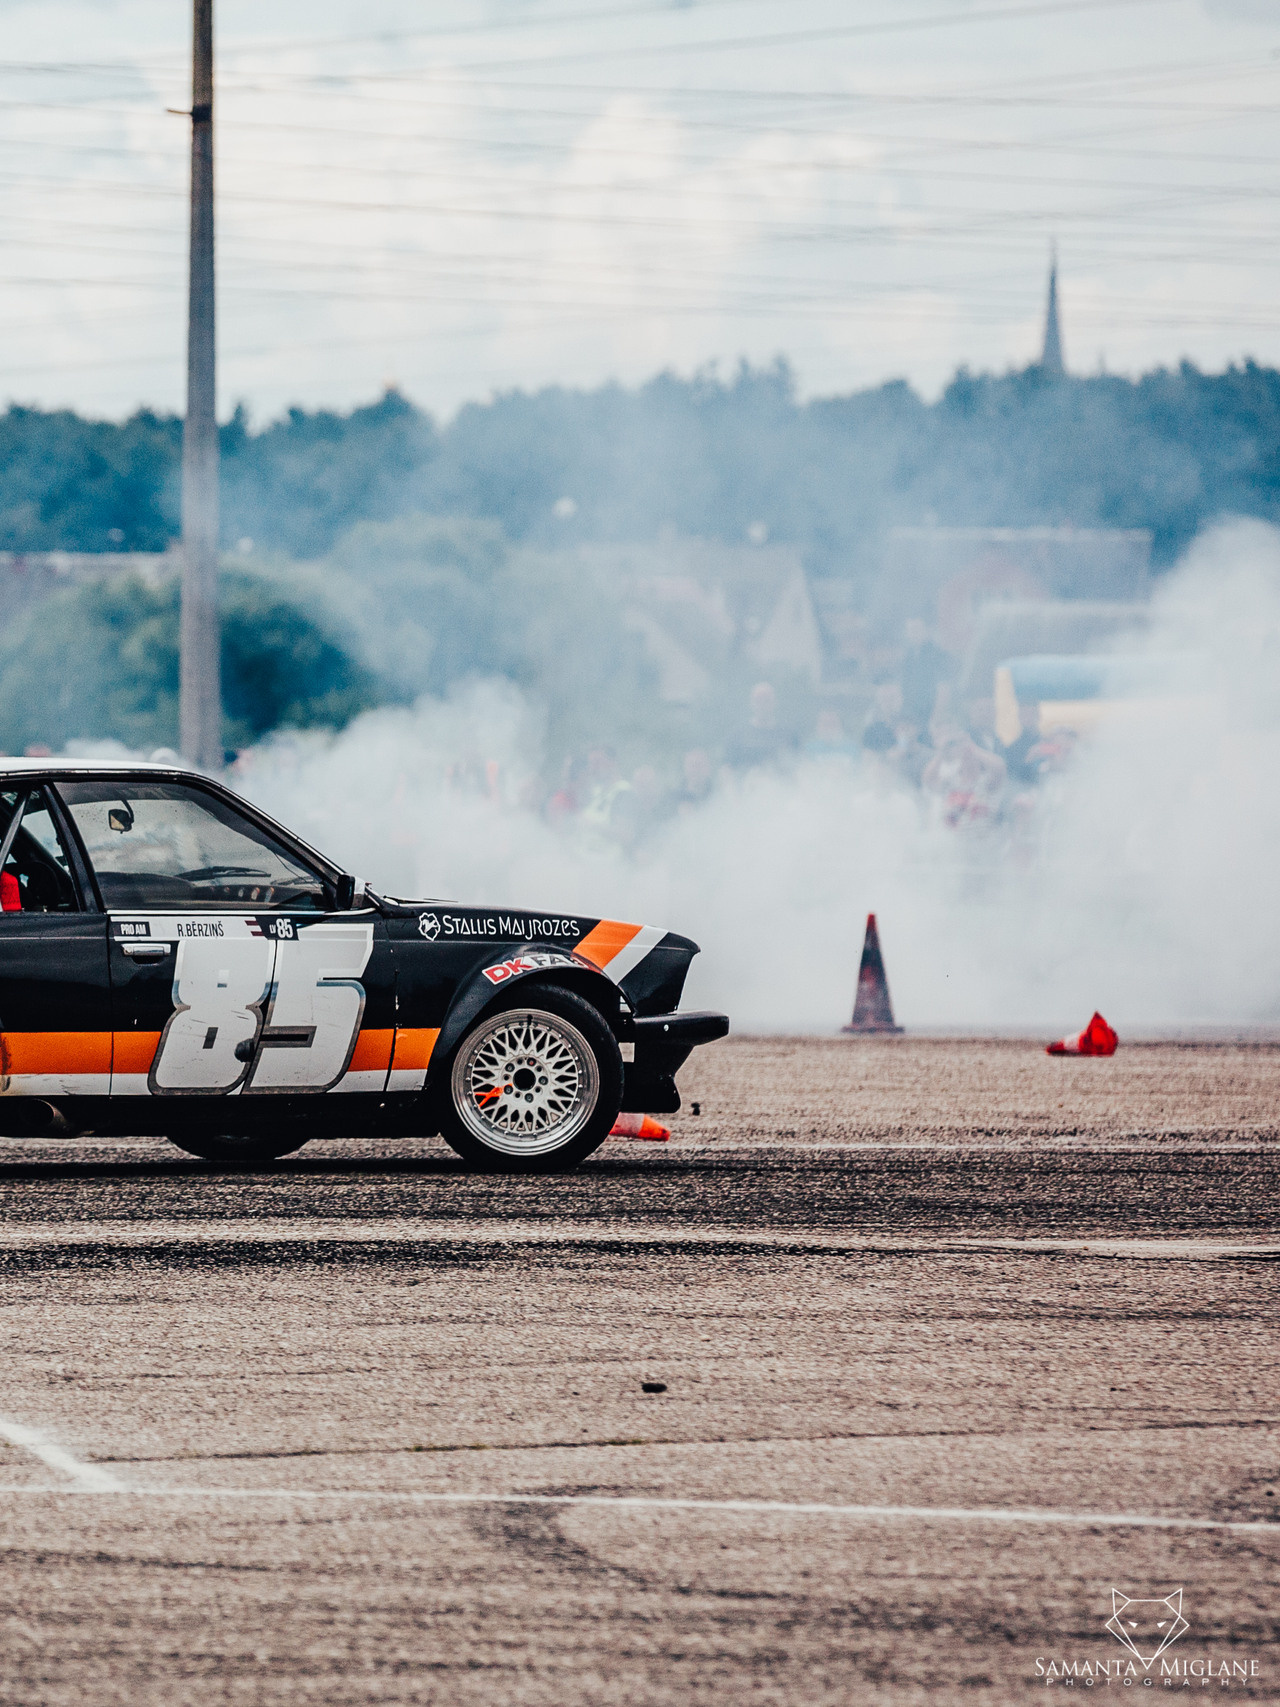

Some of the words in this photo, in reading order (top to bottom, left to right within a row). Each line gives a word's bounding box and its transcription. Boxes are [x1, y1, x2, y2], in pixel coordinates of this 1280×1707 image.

[135, 923, 147, 935] AM
[276, 918, 293, 938] 85
[442, 915, 496, 935] STALLIS
[147, 923, 374, 1096] 85
